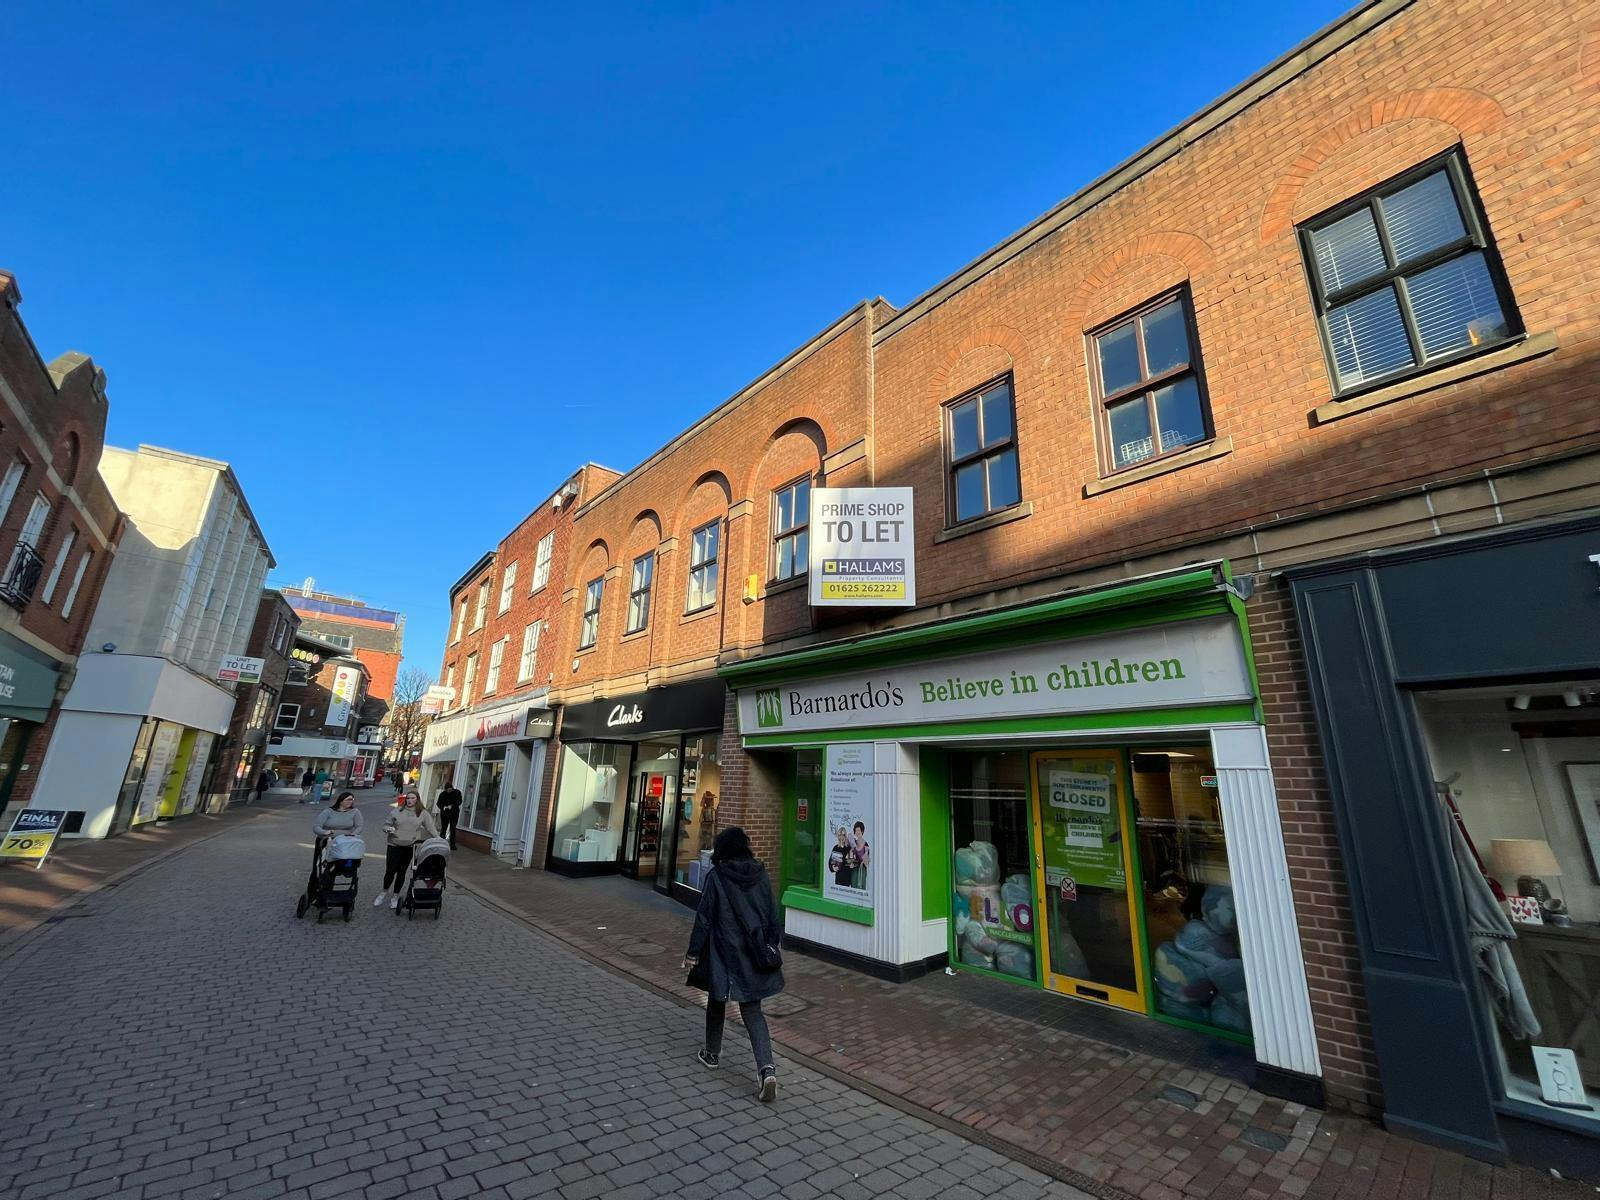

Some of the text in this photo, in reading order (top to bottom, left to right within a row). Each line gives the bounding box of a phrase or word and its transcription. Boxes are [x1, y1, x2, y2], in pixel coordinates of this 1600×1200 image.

[821, 503, 905, 517] PRIME SHOP
[822, 520, 904, 543] TO LET
[838, 560, 903, 573] HALLAMS
[829, 584, 898, 592] 01625 262222
[226, 661, 259, 671] TO LET
[919, 657, 1186, 704] Believe in children
[788, 681, 904, 716] Barnardo's
[529, 717, 554, 727] Clarks
[607, 703, 644, 728] Clarks
[484, 714, 521, 740] Santander
[1053, 790, 1107, 808] CLOSED
[20, 813, 57, 823] FINAL
[6, 838, 45, 850] 70%
